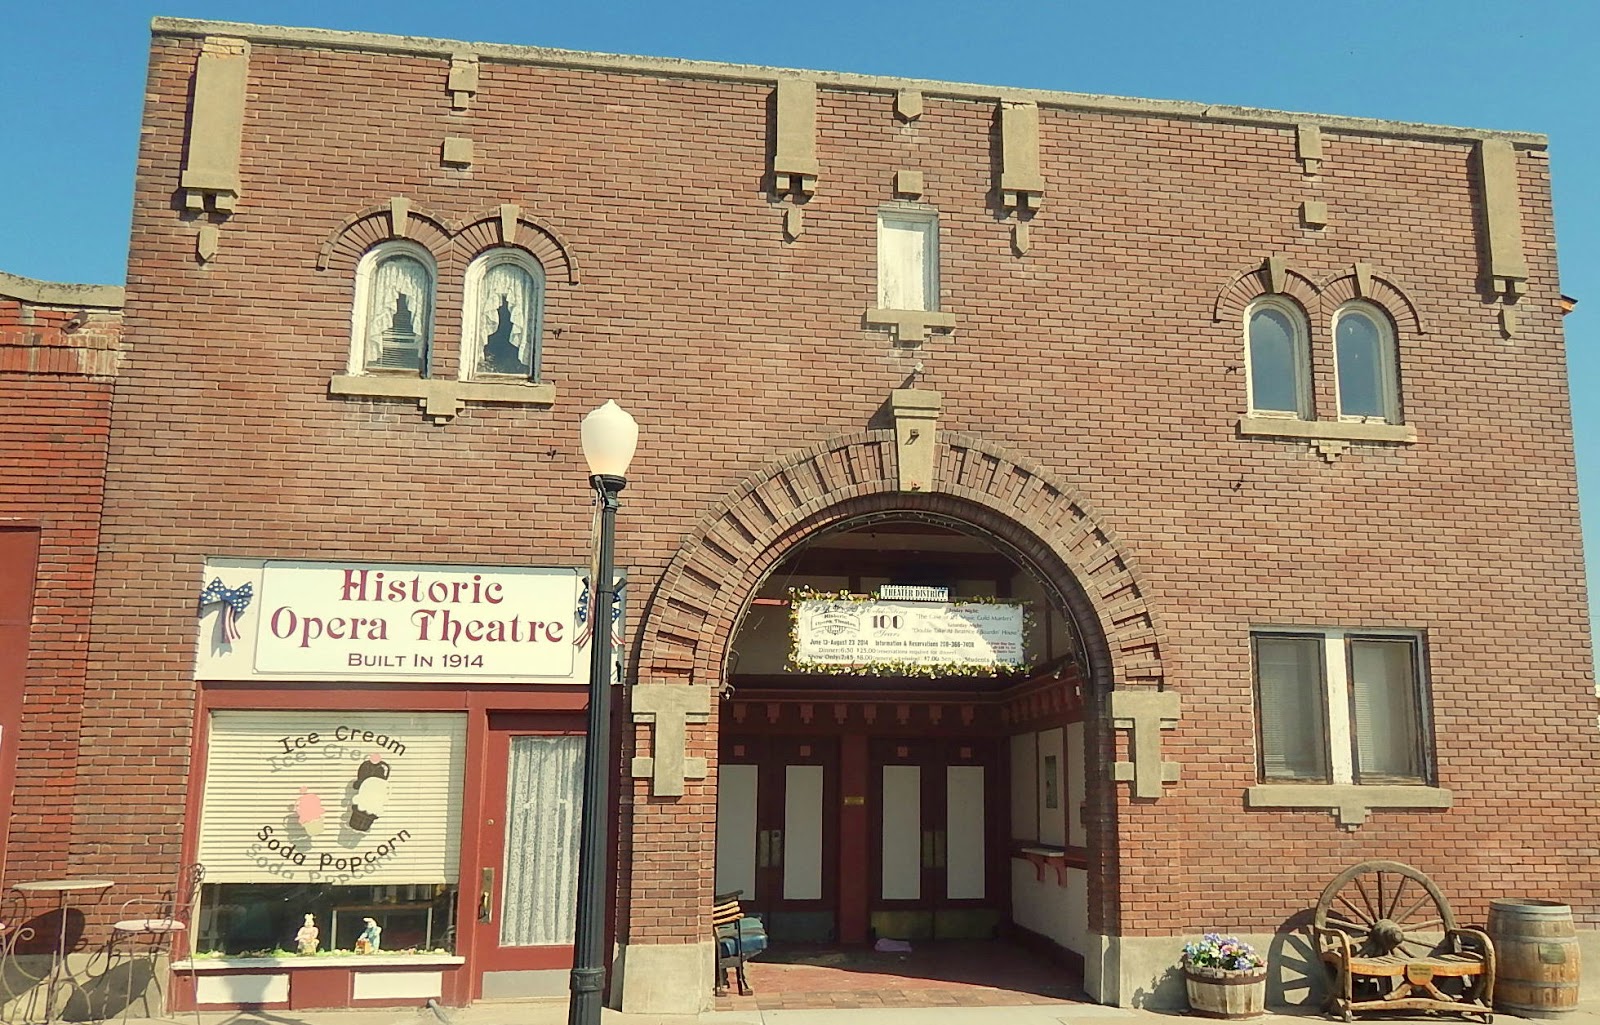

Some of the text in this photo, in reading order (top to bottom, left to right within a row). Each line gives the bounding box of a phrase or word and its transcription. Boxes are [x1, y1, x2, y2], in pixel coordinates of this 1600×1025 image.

[340, 568, 504, 604] Historic
[884, 588, 945, 598] THEATER DISTRICT
[270, 605, 564, 648] Opera Theatre
[870, 614, 905, 630] 100
[347, 653, 484, 668] BUILT IN 1914
[277, 725, 407, 757] Ice Cream
[257, 825, 307, 866] Soda
